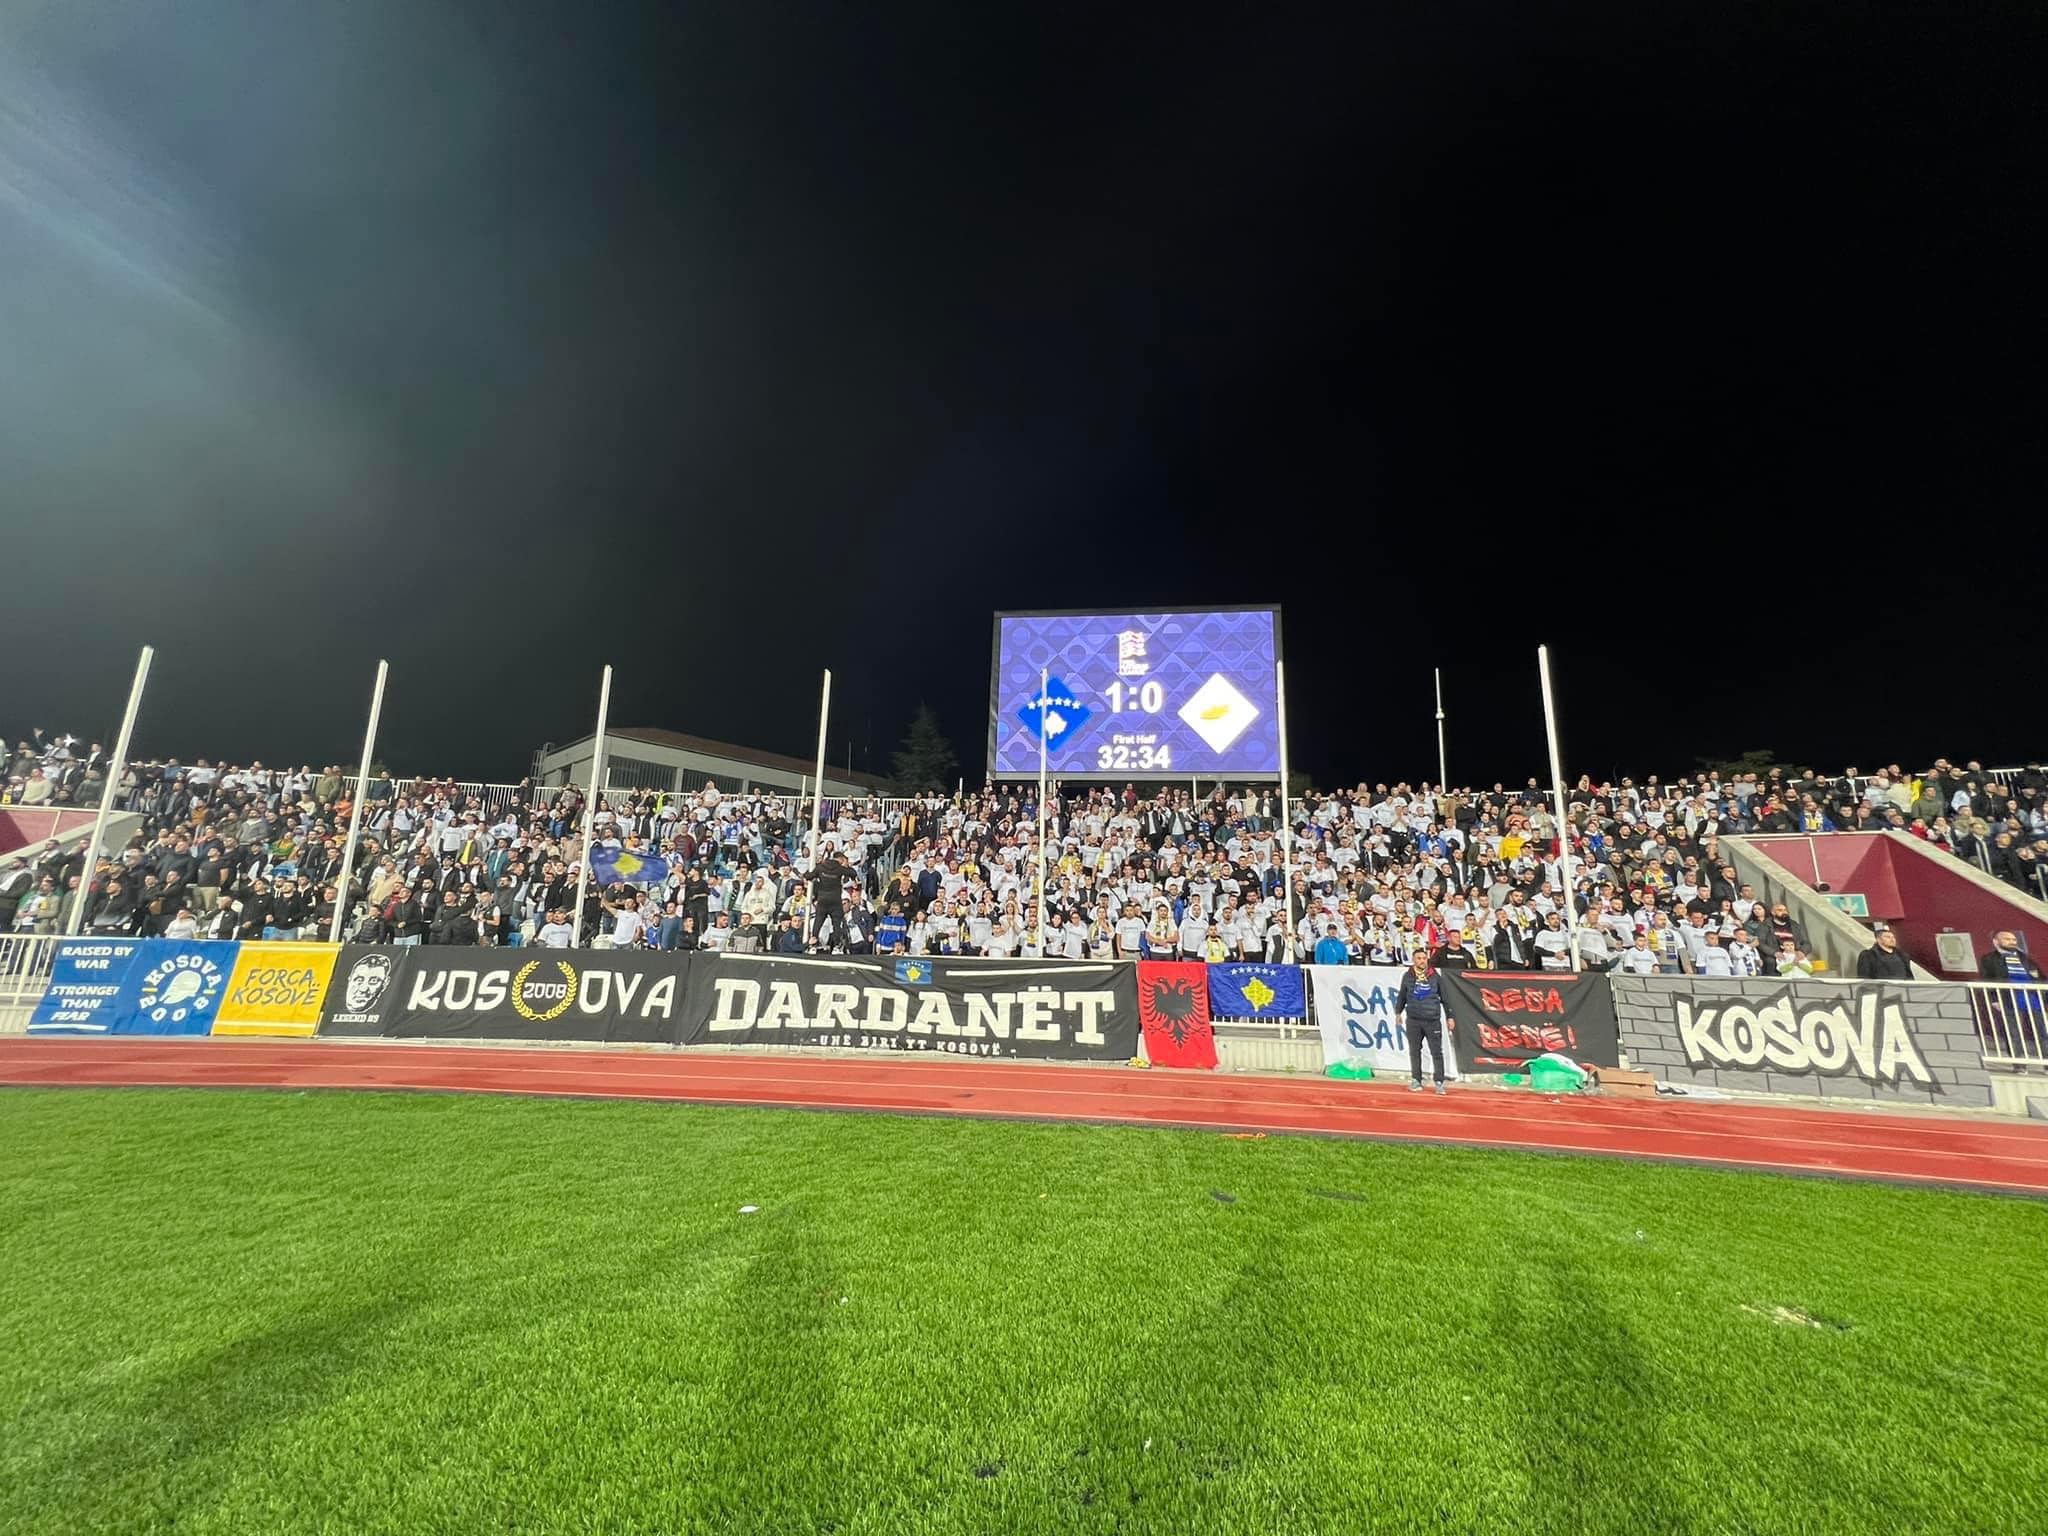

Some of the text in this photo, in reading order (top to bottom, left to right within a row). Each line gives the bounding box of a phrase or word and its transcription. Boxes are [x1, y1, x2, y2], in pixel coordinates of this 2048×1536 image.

[1105, 682, 1162, 713] 1:0
[1098, 746, 1171, 769] 32:34
[62, 947, 134, 956] RAISED BY
[75, 960, 110, 969] WAR
[144, 955, 222, 988] KOSOVA
[61, 999, 102, 1008] THAN
[407, 971, 676, 1018] KOS 2008 OVA
[50, 1012, 91, 1021] FEAR
[709, 978, 1116, 1045] DARDANËT
[906, 1039, 927, 1050] YT
[1676, 991, 1932, 1083] KOSOVA
